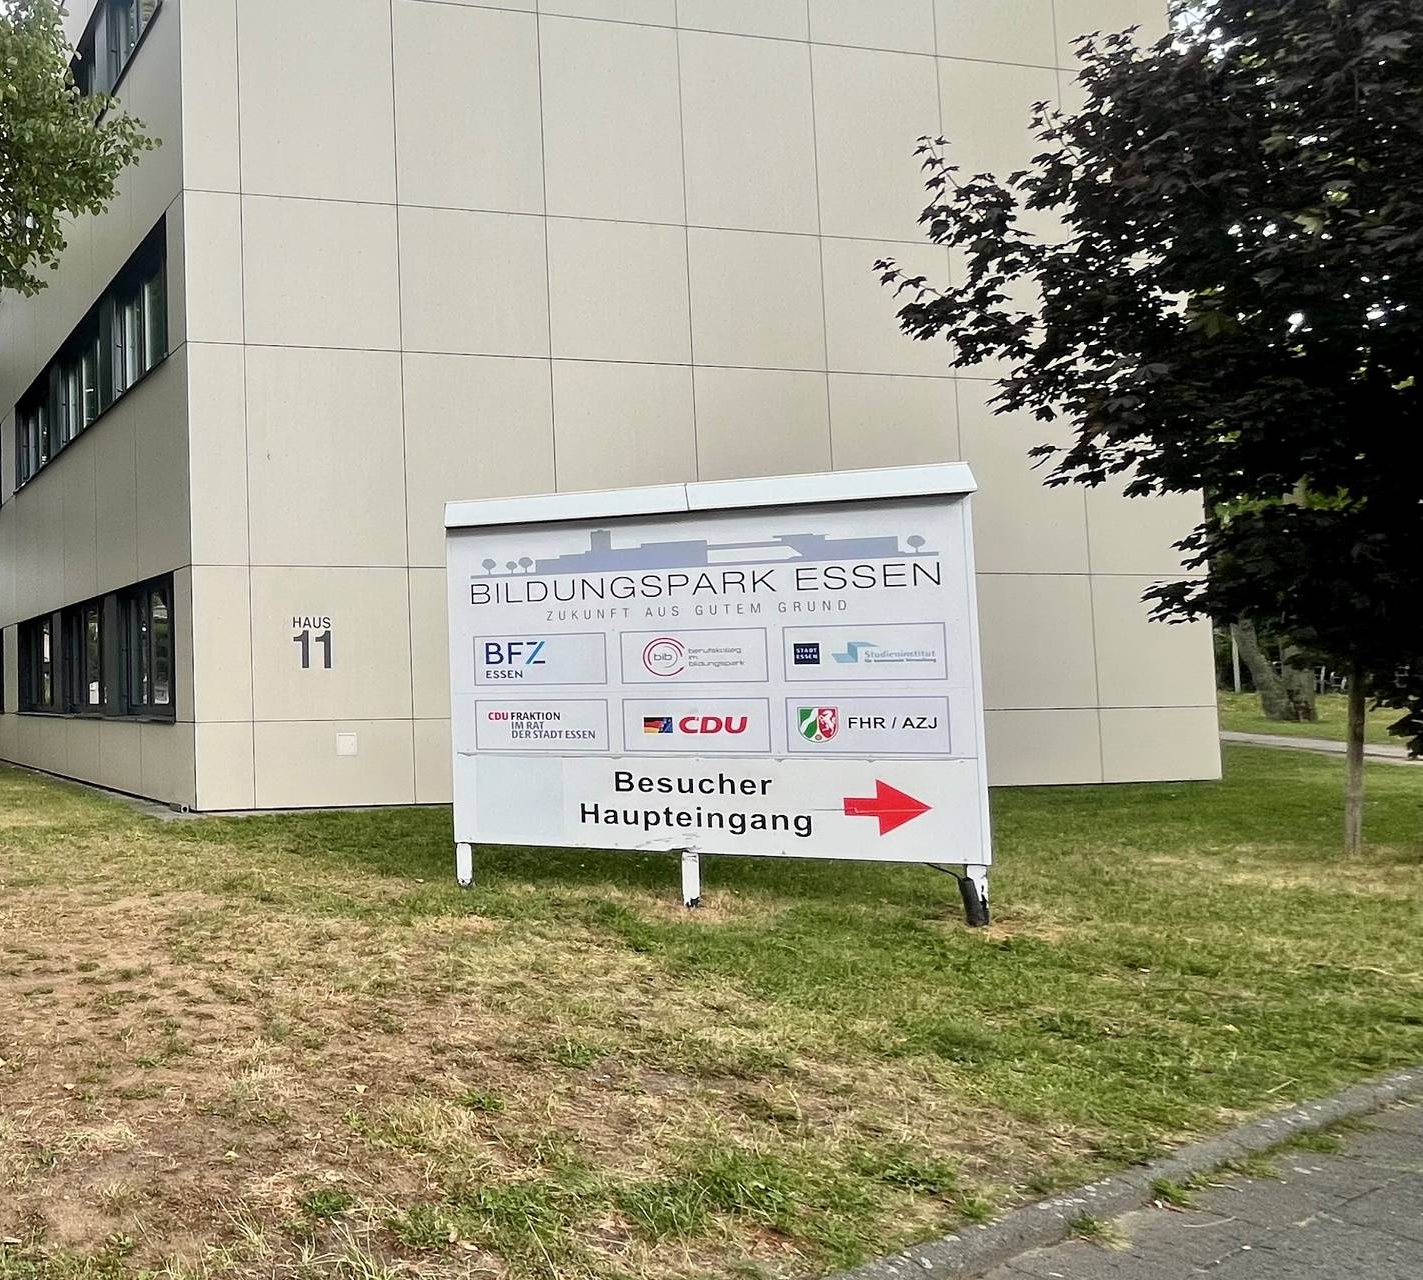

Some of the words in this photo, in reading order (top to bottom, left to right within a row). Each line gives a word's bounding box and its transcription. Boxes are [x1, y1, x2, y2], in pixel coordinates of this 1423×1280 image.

[470, 569, 777, 605] BILDUNGSPARK
[795, 561, 941, 592] ESSEN
[546, 607, 630, 622] ZUKUNFT
[645, 605, 680, 618] AUS
[694, 603, 761, 616] GUTEM
[778, 599, 848, 613] GRUND
[292, 616, 332, 629] HAUS
[293, 630, 332, 668] 11
[485, 641, 545, 665] BFZ
[653, 653, 673, 661] bib
[485, 670, 523, 679] ESSEN
[488, 712, 509, 720] CDU
[510, 712, 561, 720] FRAKTION
[848, 717, 886, 729] FHR
[902, 717, 938, 729] AZJ
[511, 721, 524, 730] IM
[526, 721, 545, 730] RAT
[678, 716, 748, 734] CDU
[511, 730, 532, 739] DER
[533, 730, 563, 739] STADT
[565, 730, 596, 739] ESSEN
[614, 771, 773, 795] Besucher
[580, 803, 813, 838] Haupteingang
